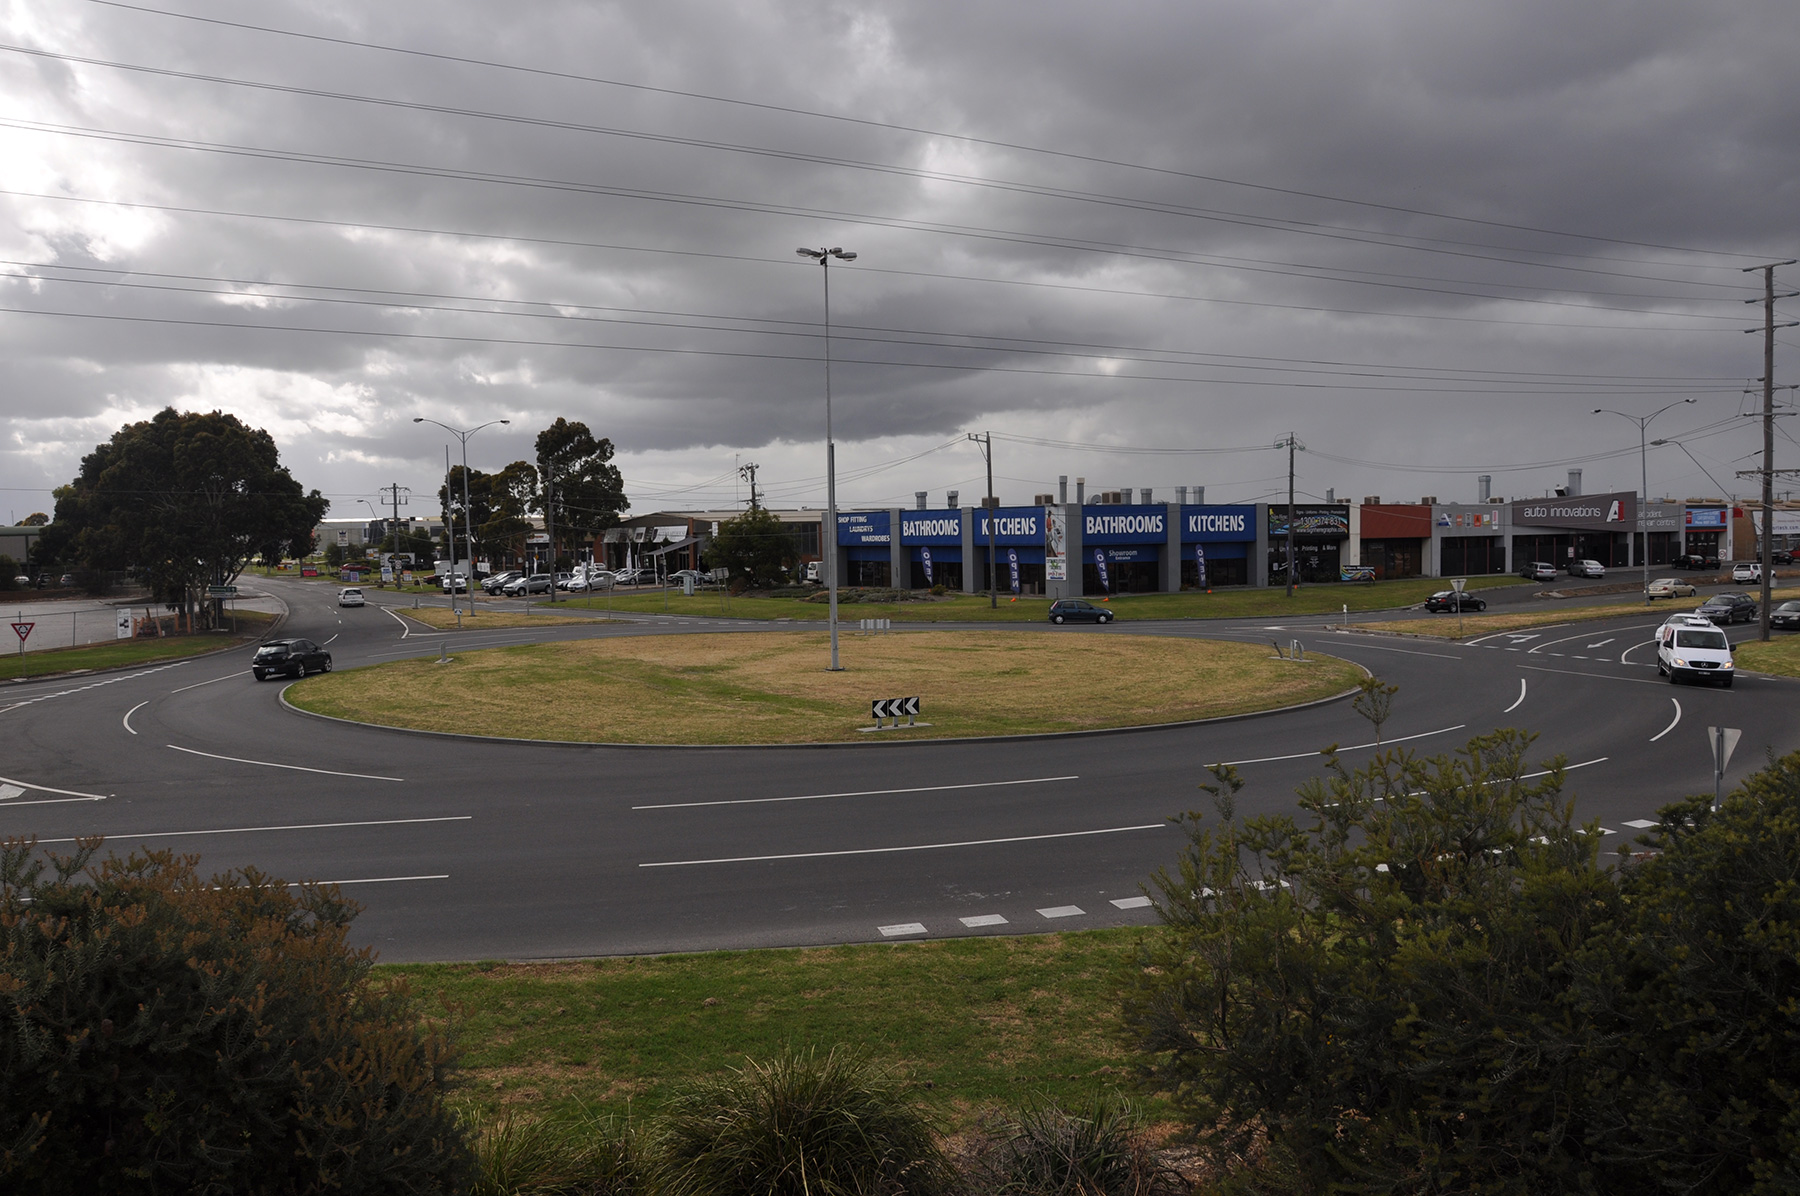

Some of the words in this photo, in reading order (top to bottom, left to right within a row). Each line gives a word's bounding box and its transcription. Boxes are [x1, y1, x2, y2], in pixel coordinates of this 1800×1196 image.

[1524, 505, 1547, 518] auto
[1550, 504, 1601, 518] innovations
[837, 516, 849, 524] SHOP
[850, 515, 867, 523] FITTING
[1086, 515, 1164, 534] BATHROOMS
[1189, 515, 1245, 532] KITCHENS
[1300, 516, 1315, 525] 1300
[1317, 516, 1328, 525] 374
[1330, 516, 1341, 525] 831
[1638, 519, 1655, 527] reair
[1657, 519, 1675, 527] centre
[902, 518, 960, 537] BATHROOMS
[981, 517, 1037, 536] KTCHENS
[861, 534, 890, 543] WARDROBES
[1108, 549, 1138, 557] Showroom
